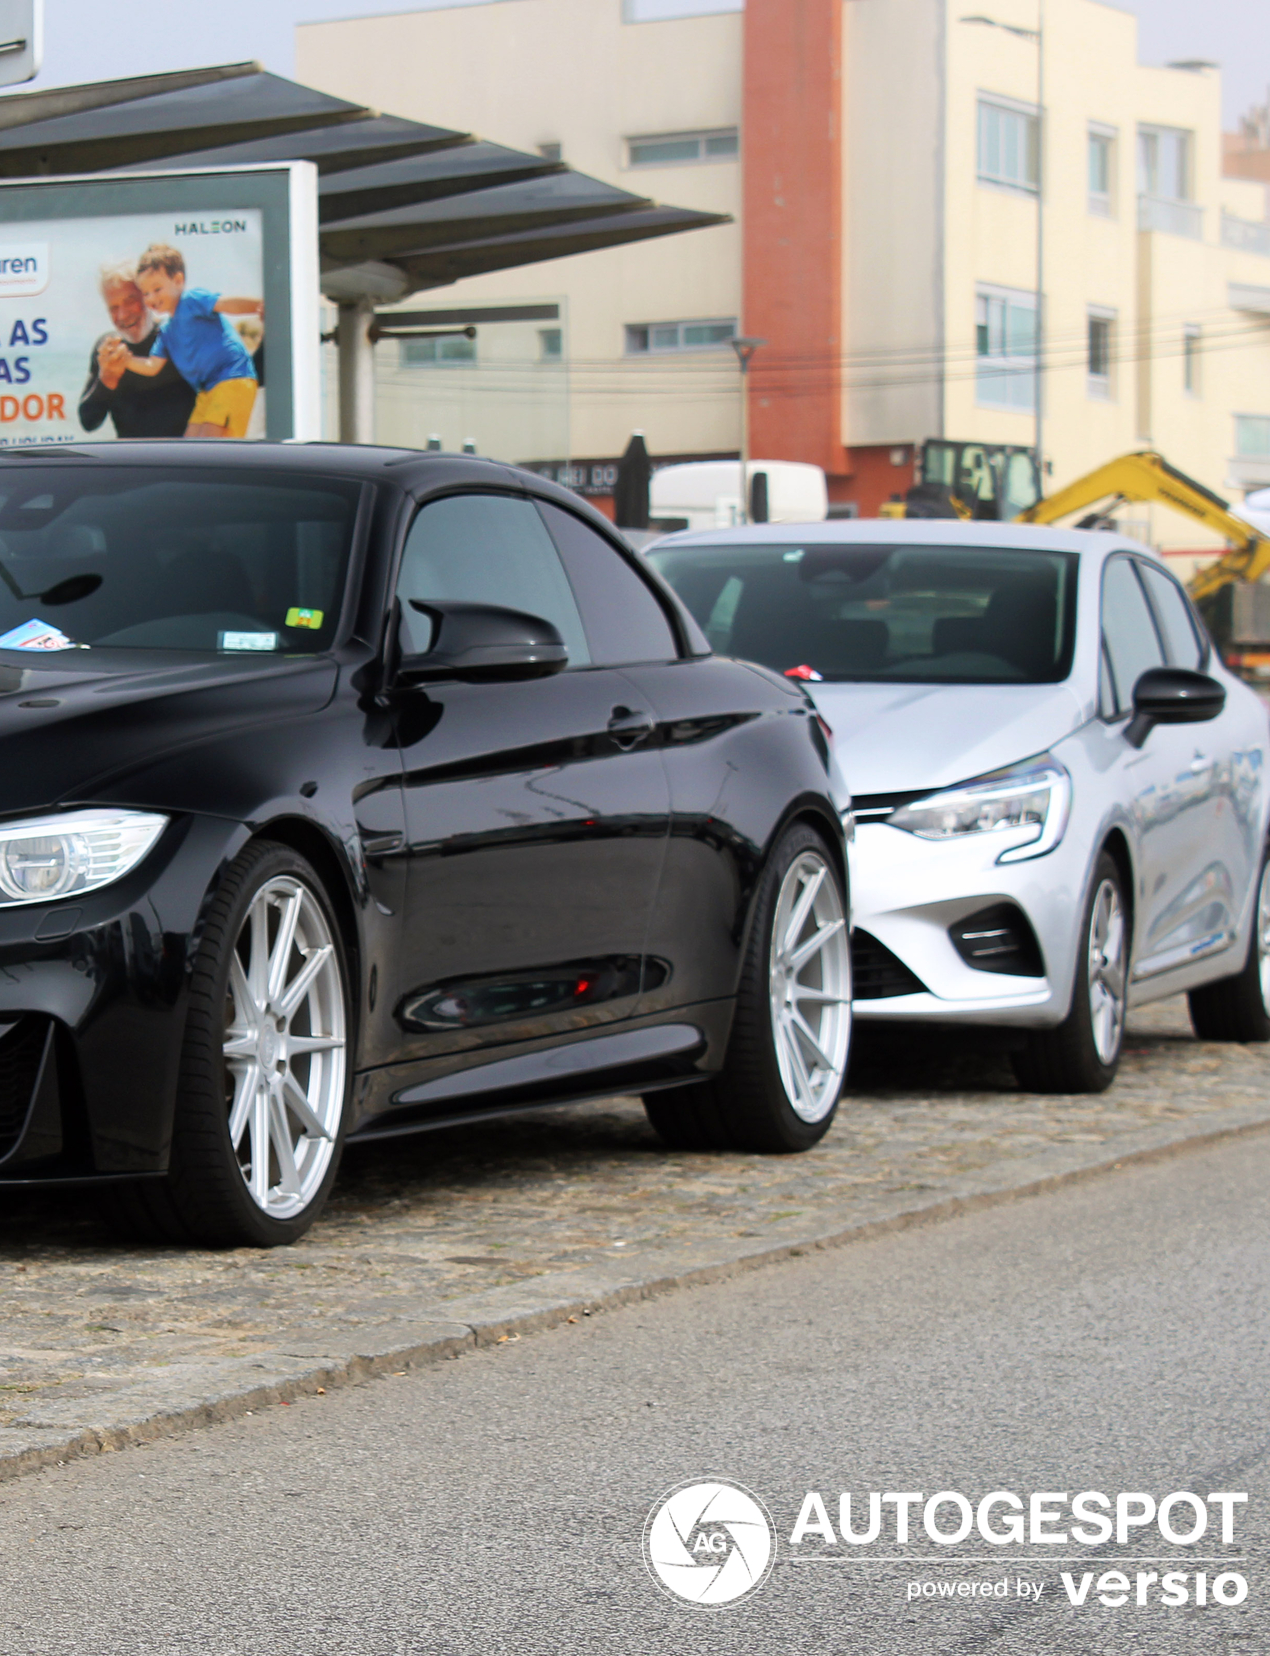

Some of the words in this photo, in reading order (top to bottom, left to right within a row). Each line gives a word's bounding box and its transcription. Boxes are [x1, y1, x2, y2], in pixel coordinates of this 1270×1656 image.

[175, 220, 246, 235] HALEON
[9, 318, 48, 347] AS
[0, 393, 66, 423] DOR
